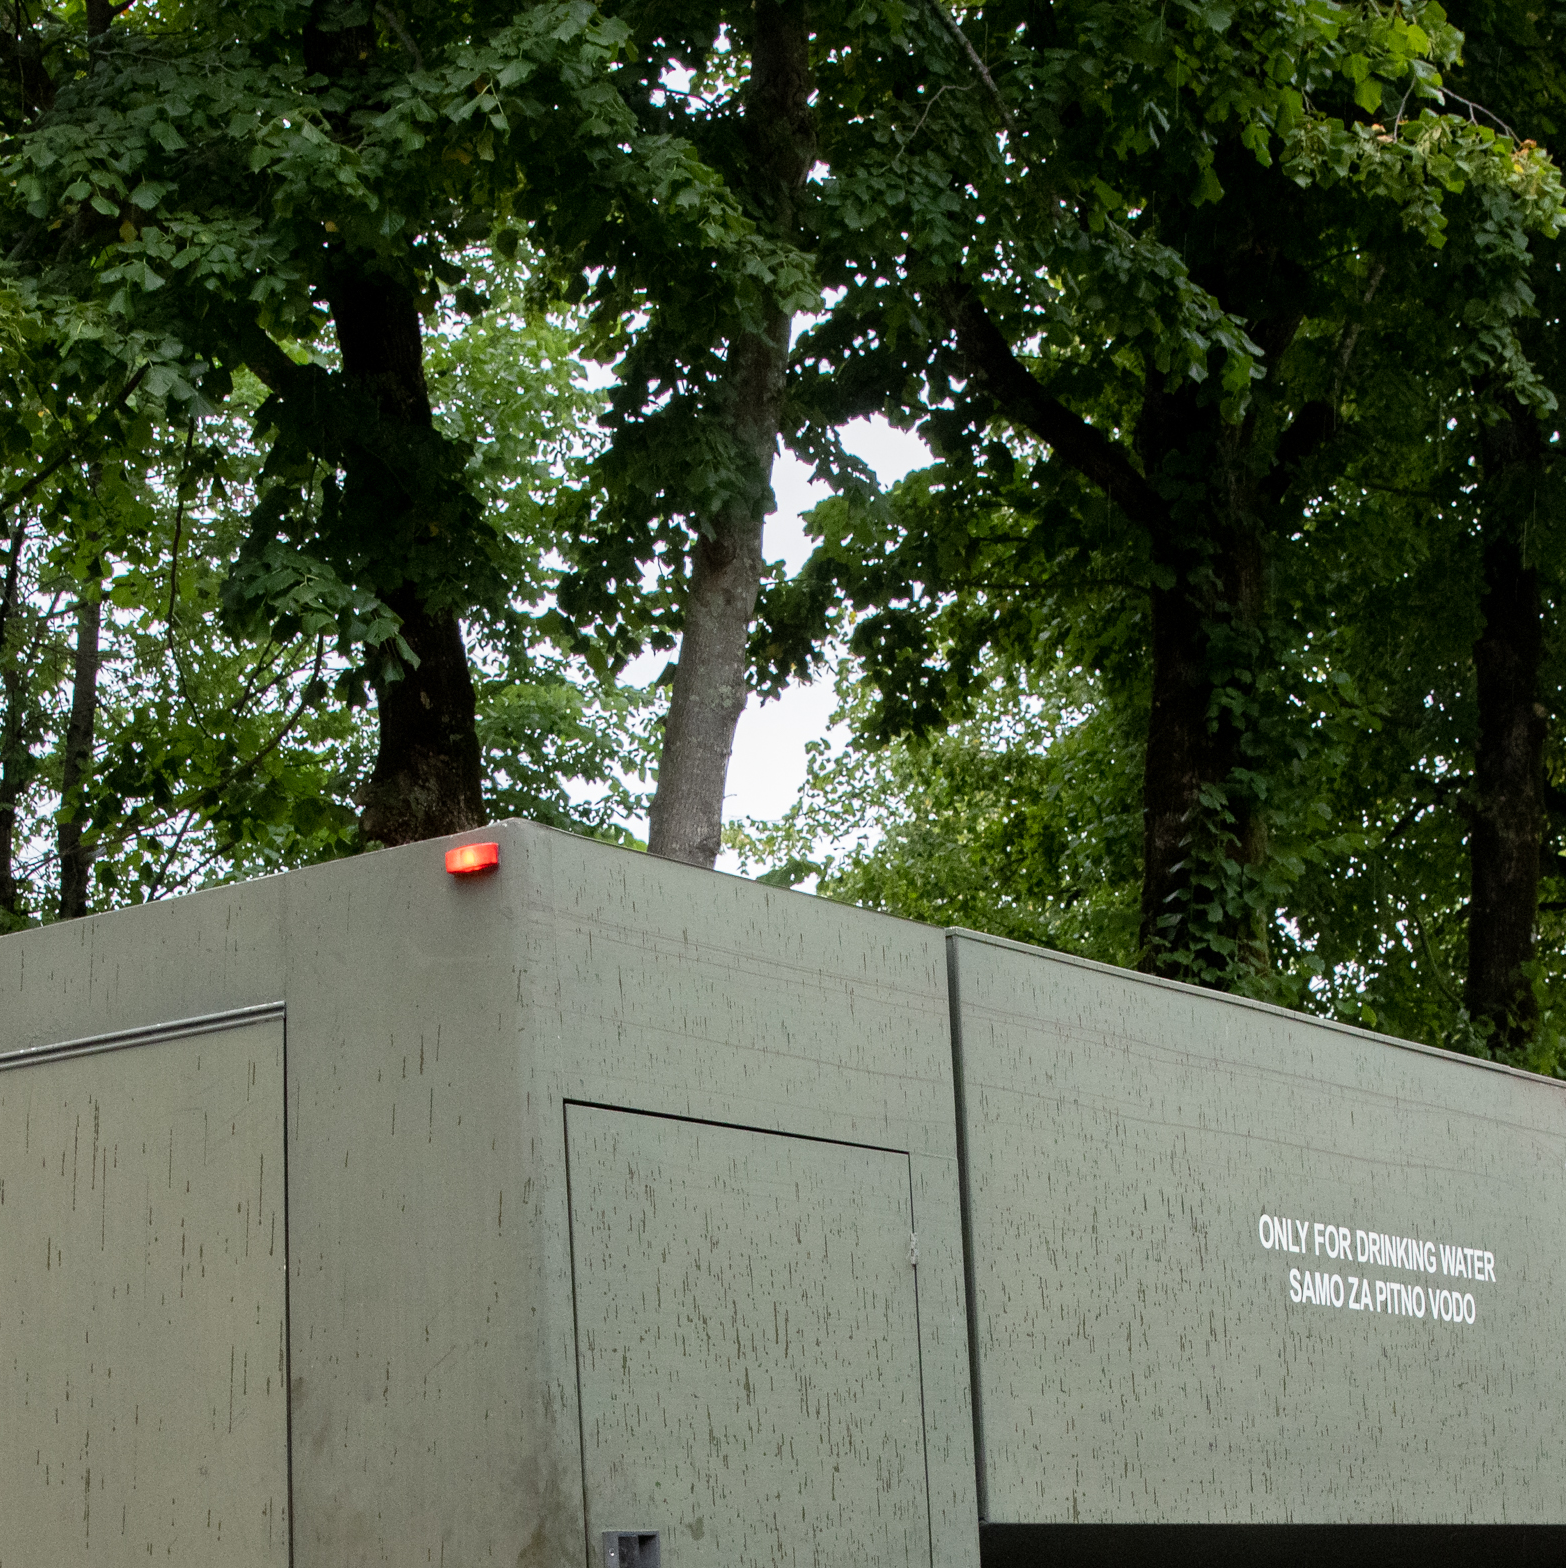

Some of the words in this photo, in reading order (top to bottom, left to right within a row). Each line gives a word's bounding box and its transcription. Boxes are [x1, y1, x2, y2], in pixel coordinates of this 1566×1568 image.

[1258, 1214, 1309, 1253] ONLY
[1313, 1222, 1353, 1261] FOR
[1355, 1229, 1436, 1273] DRINKING
[1439, 1243, 1496, 1282] WATER
[1289, 1268, 1345, 1307] SAMO
[1347, 1276, 1373, 1311] ZA
[1375, 1280, 1426, 1318] PITNO
[1428, 1287, 1476, 1325] VODO
